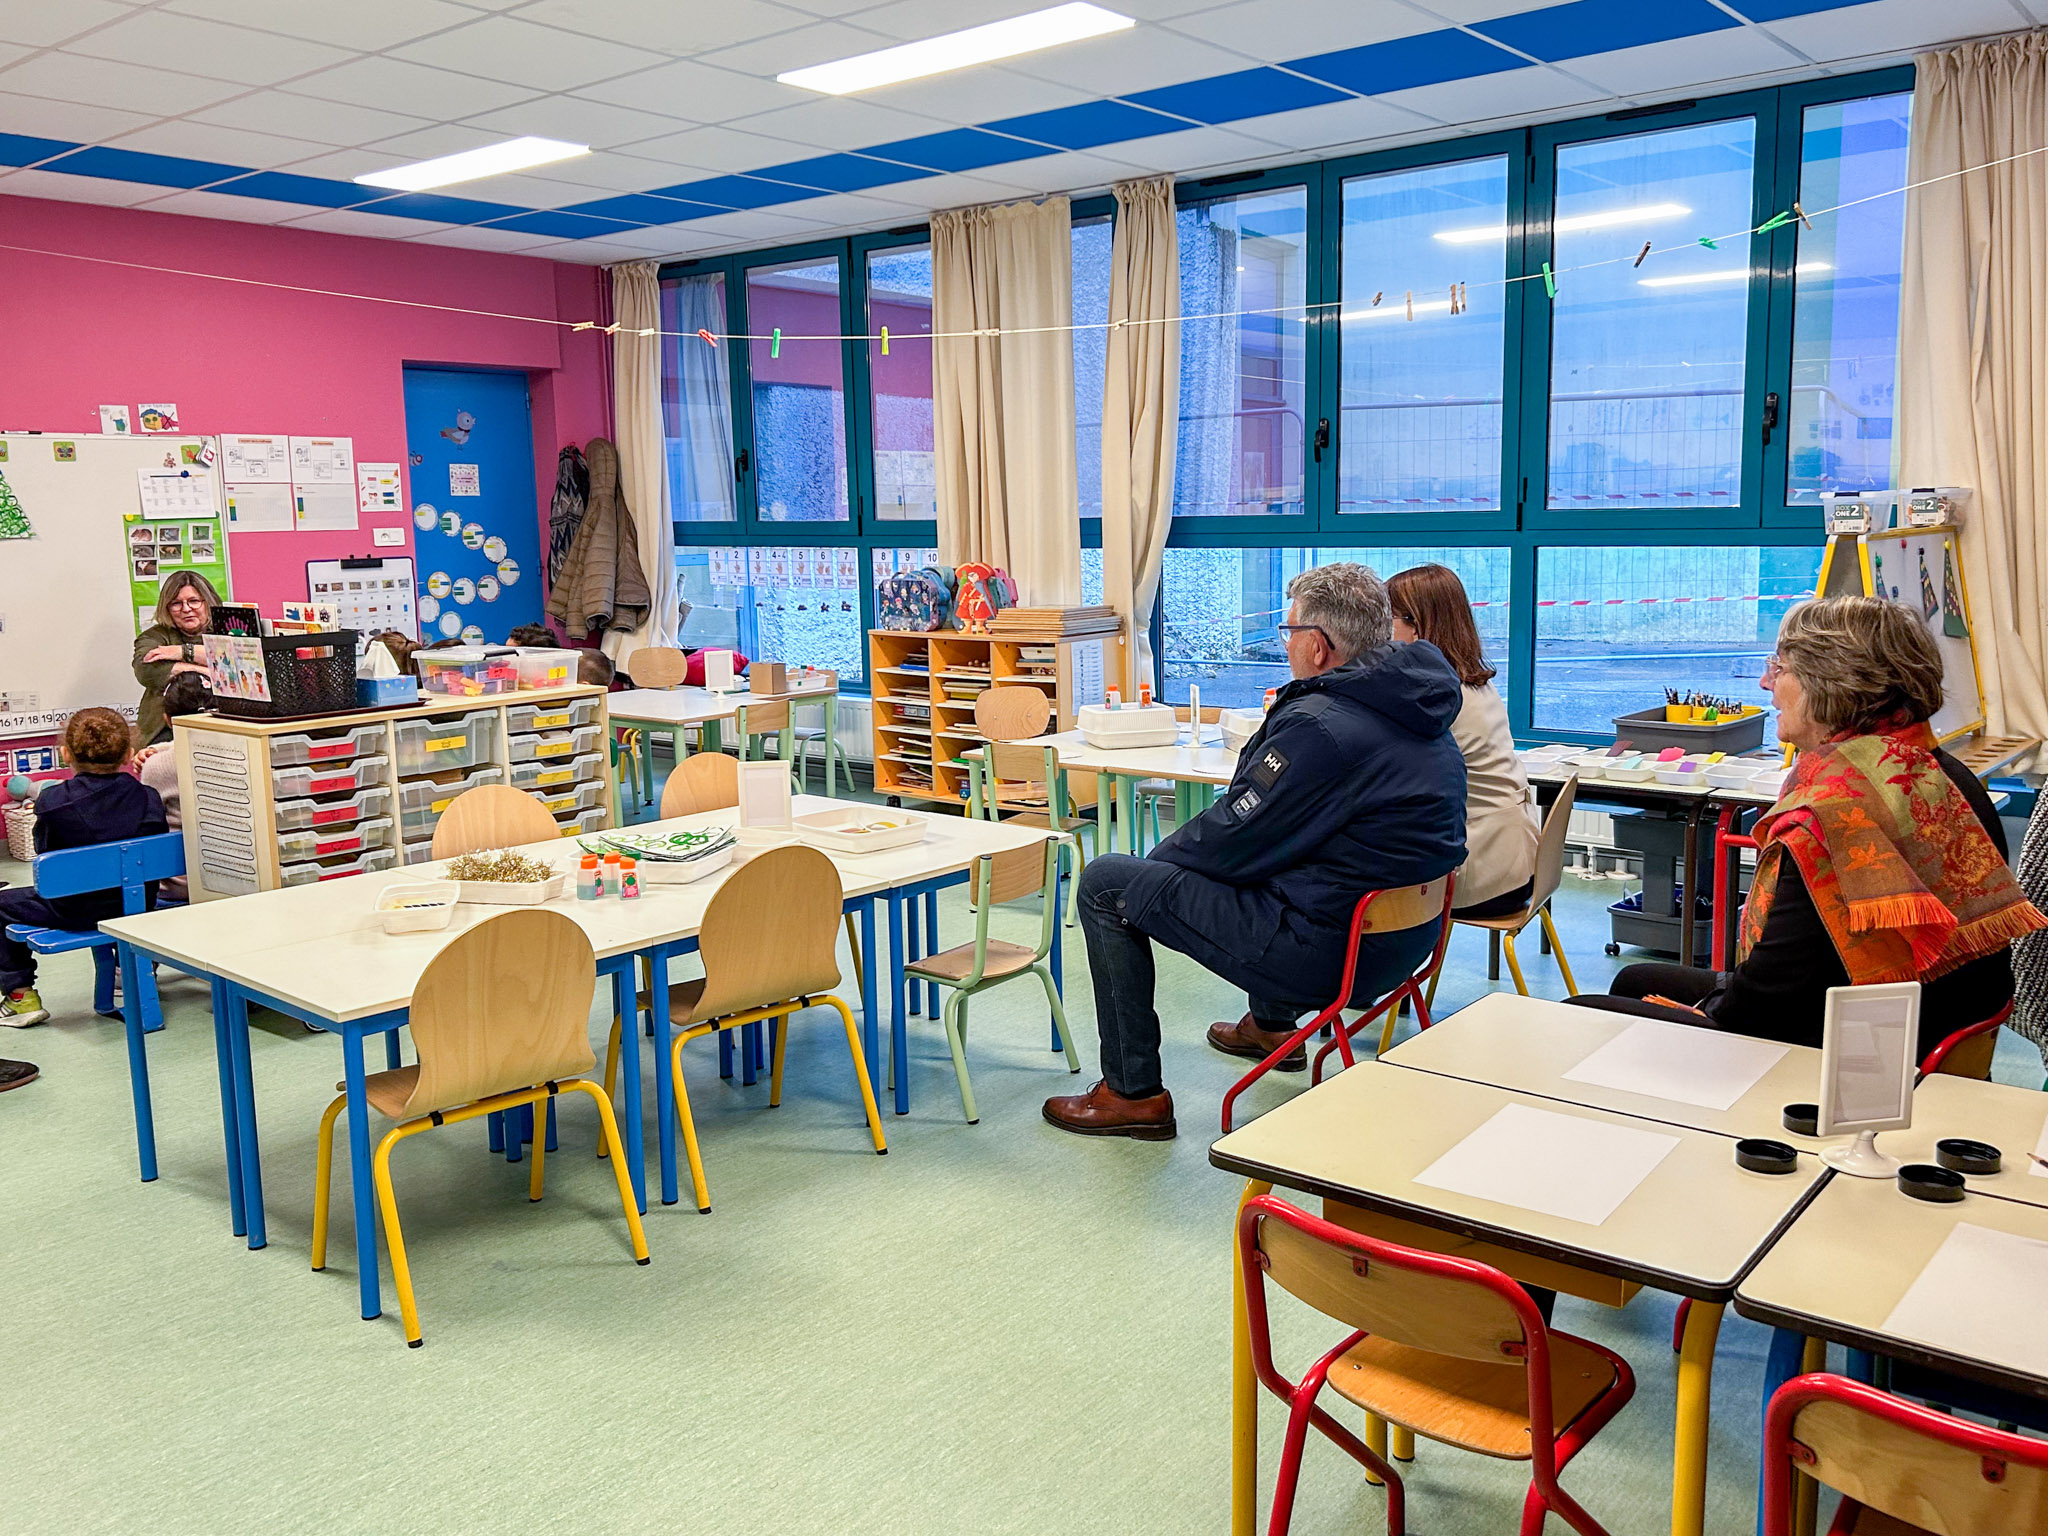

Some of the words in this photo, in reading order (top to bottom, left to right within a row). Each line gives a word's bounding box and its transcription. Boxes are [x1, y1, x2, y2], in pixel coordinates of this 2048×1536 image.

[1850, 505, 1860, 516] 2
[1926, 500, 1934, 510] 2
[13, 716, 25, 726] 17
[28, 715, 39, 724] 18
[41, 714, 53, 723] 19
[55, 712, 68, 722] 20
[122, 707, 135, 716] 25
